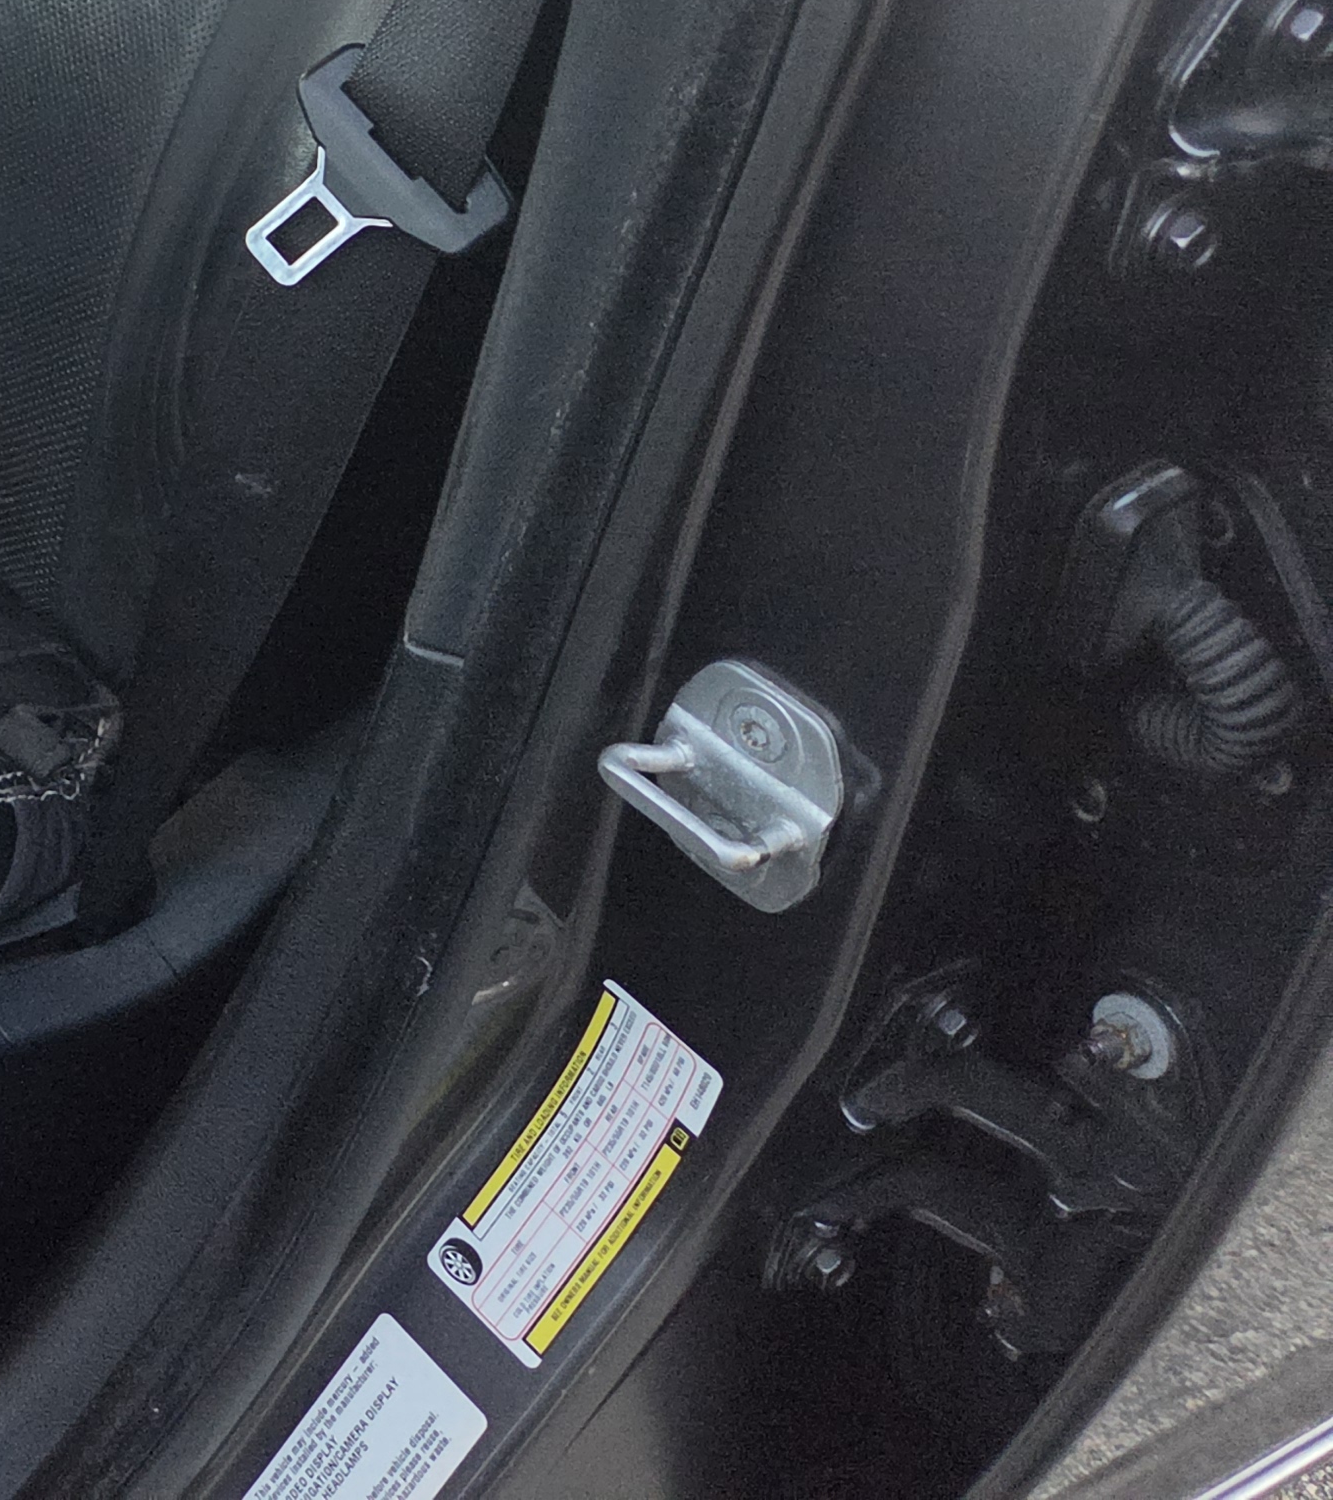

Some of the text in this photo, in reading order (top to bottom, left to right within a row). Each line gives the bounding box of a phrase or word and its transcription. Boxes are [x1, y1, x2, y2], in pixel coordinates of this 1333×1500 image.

[510, 1050, 587, 1162] TIRE AND LOADING INFORMATION
[269, 1454, 293, 1484] vehicle
[291, 1436, 307, 1456] may
[302, 1406, 329, 1439] include
[326, 1373, 354, 1408] mercury
[358, 1336, 380, 1365] added
[364, 1376, 399, 1421] DISPLAY
[289, 1438, 318, 1476] installed
[314, 1427, 328, 1442] by
[323, 1414, 337, 1430] the
[304, 1434, 338, 1480] DISPLAY
[321, 1440, 369, 1500] HEADLAMPS
[386, 1446, 412, 1478] vehicle
[408, 1411, 439, 1449] disposal.
[399, 1452, 422, 1483] please
